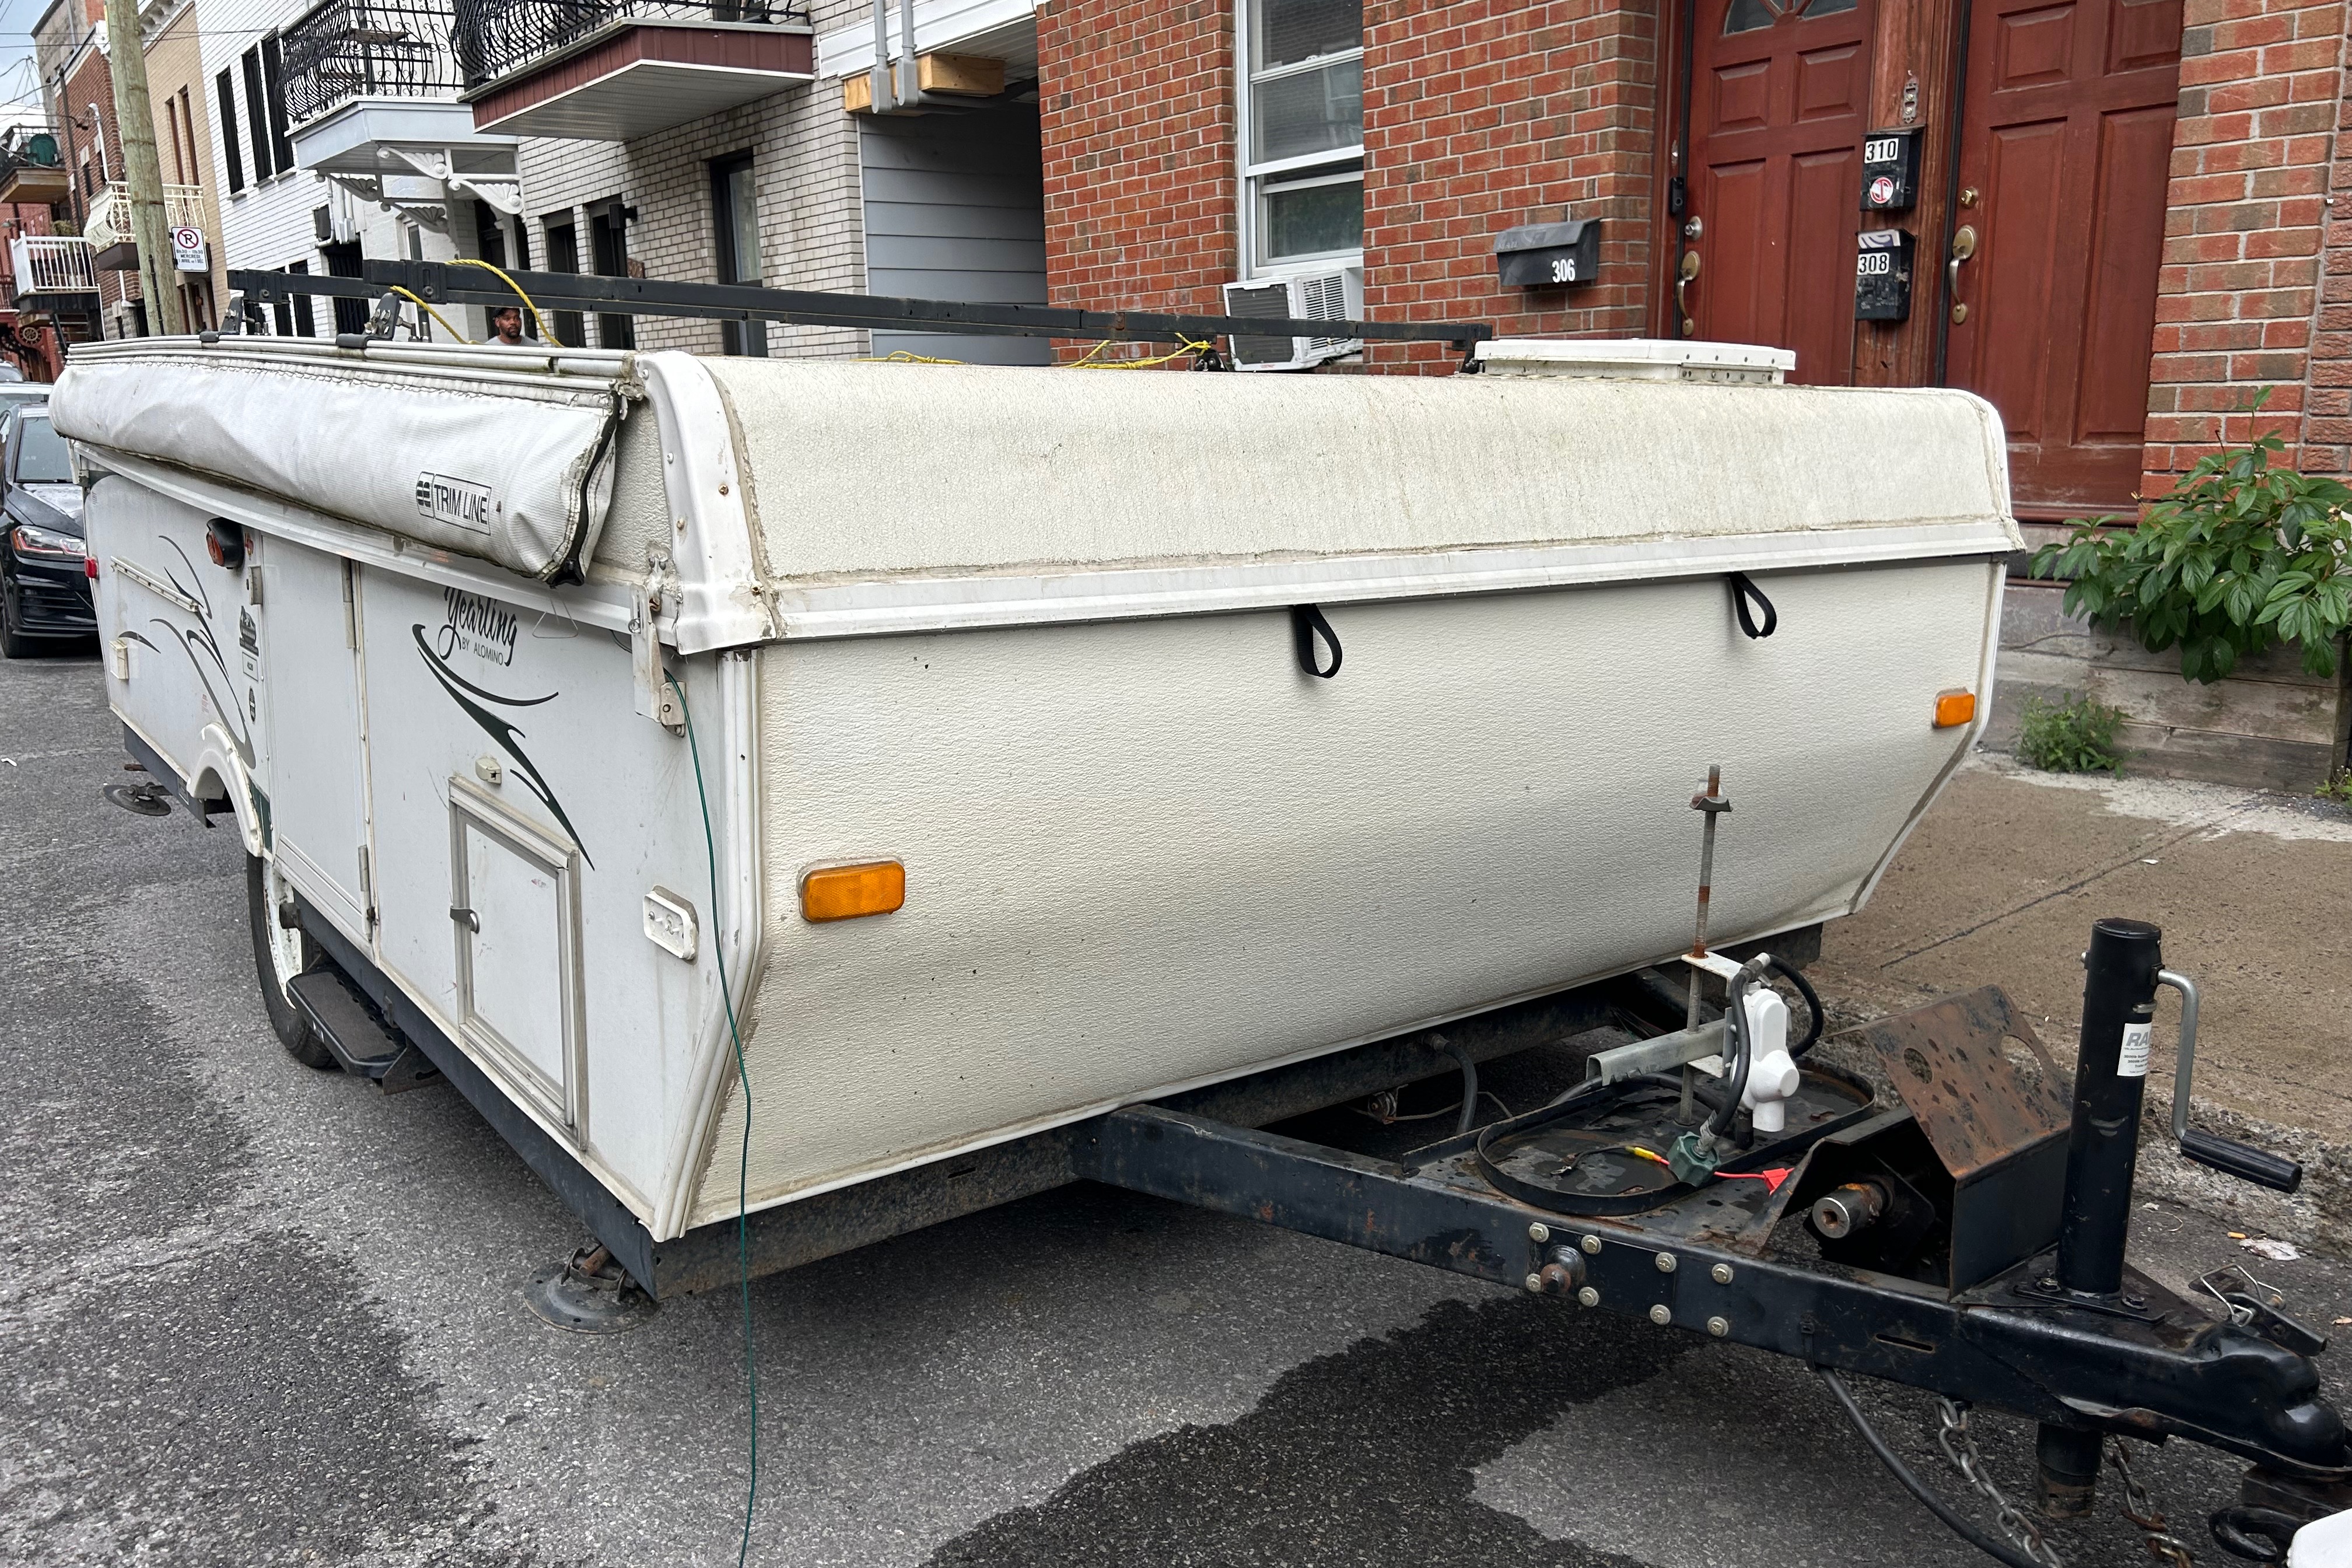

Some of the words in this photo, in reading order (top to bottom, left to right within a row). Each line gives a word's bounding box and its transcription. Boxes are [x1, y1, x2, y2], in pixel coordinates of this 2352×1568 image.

[1866, 141, 1896, 161] 310
[1552, 258, 1576, 284] 306
[1859, 254, 1887, 273] 308
[433, 484, 462, 517] TRIM
[463, 491, 488, 525] LINE
[462, 636, 470, 651] BY
[2125, 1031, 2151, 1046] RA
